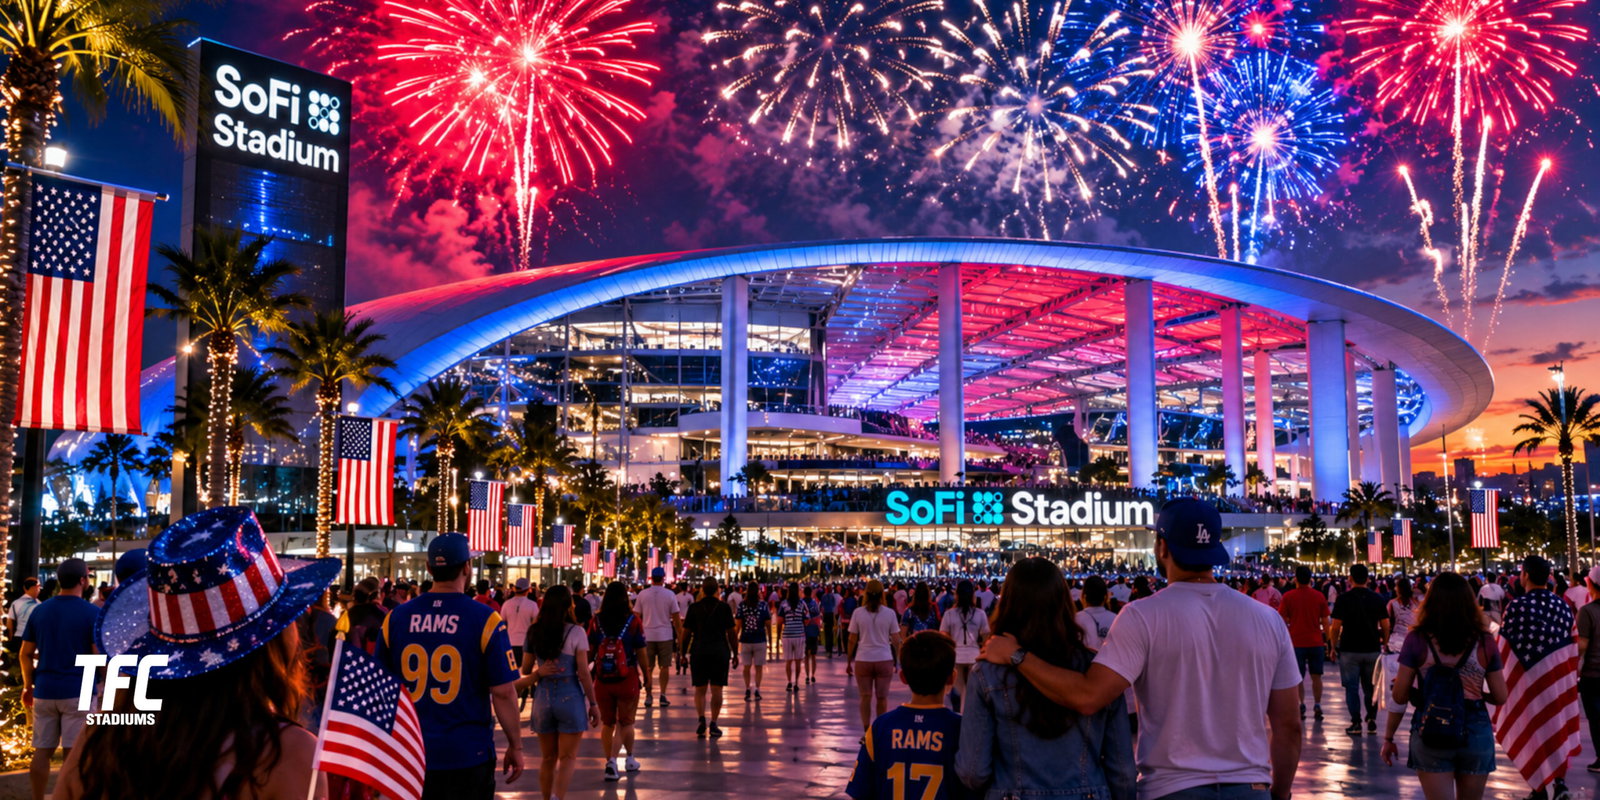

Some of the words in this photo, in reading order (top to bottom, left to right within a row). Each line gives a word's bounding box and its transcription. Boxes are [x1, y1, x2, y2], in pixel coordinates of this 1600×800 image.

[214, 64, 301, 125] SoFi
[213, 113, 340, 173] Stadium
[885, 490, 965, 526] SoFi
[1011, 490, 1155, 526] Stadium
[1195, 523, 1211, 544] LA
[409, 614, 460, 634] RAMS
[401, 643, 462, 705] 99
[891, 728, 945, 752] RAMS
[886, 761, 944, 800] 17
